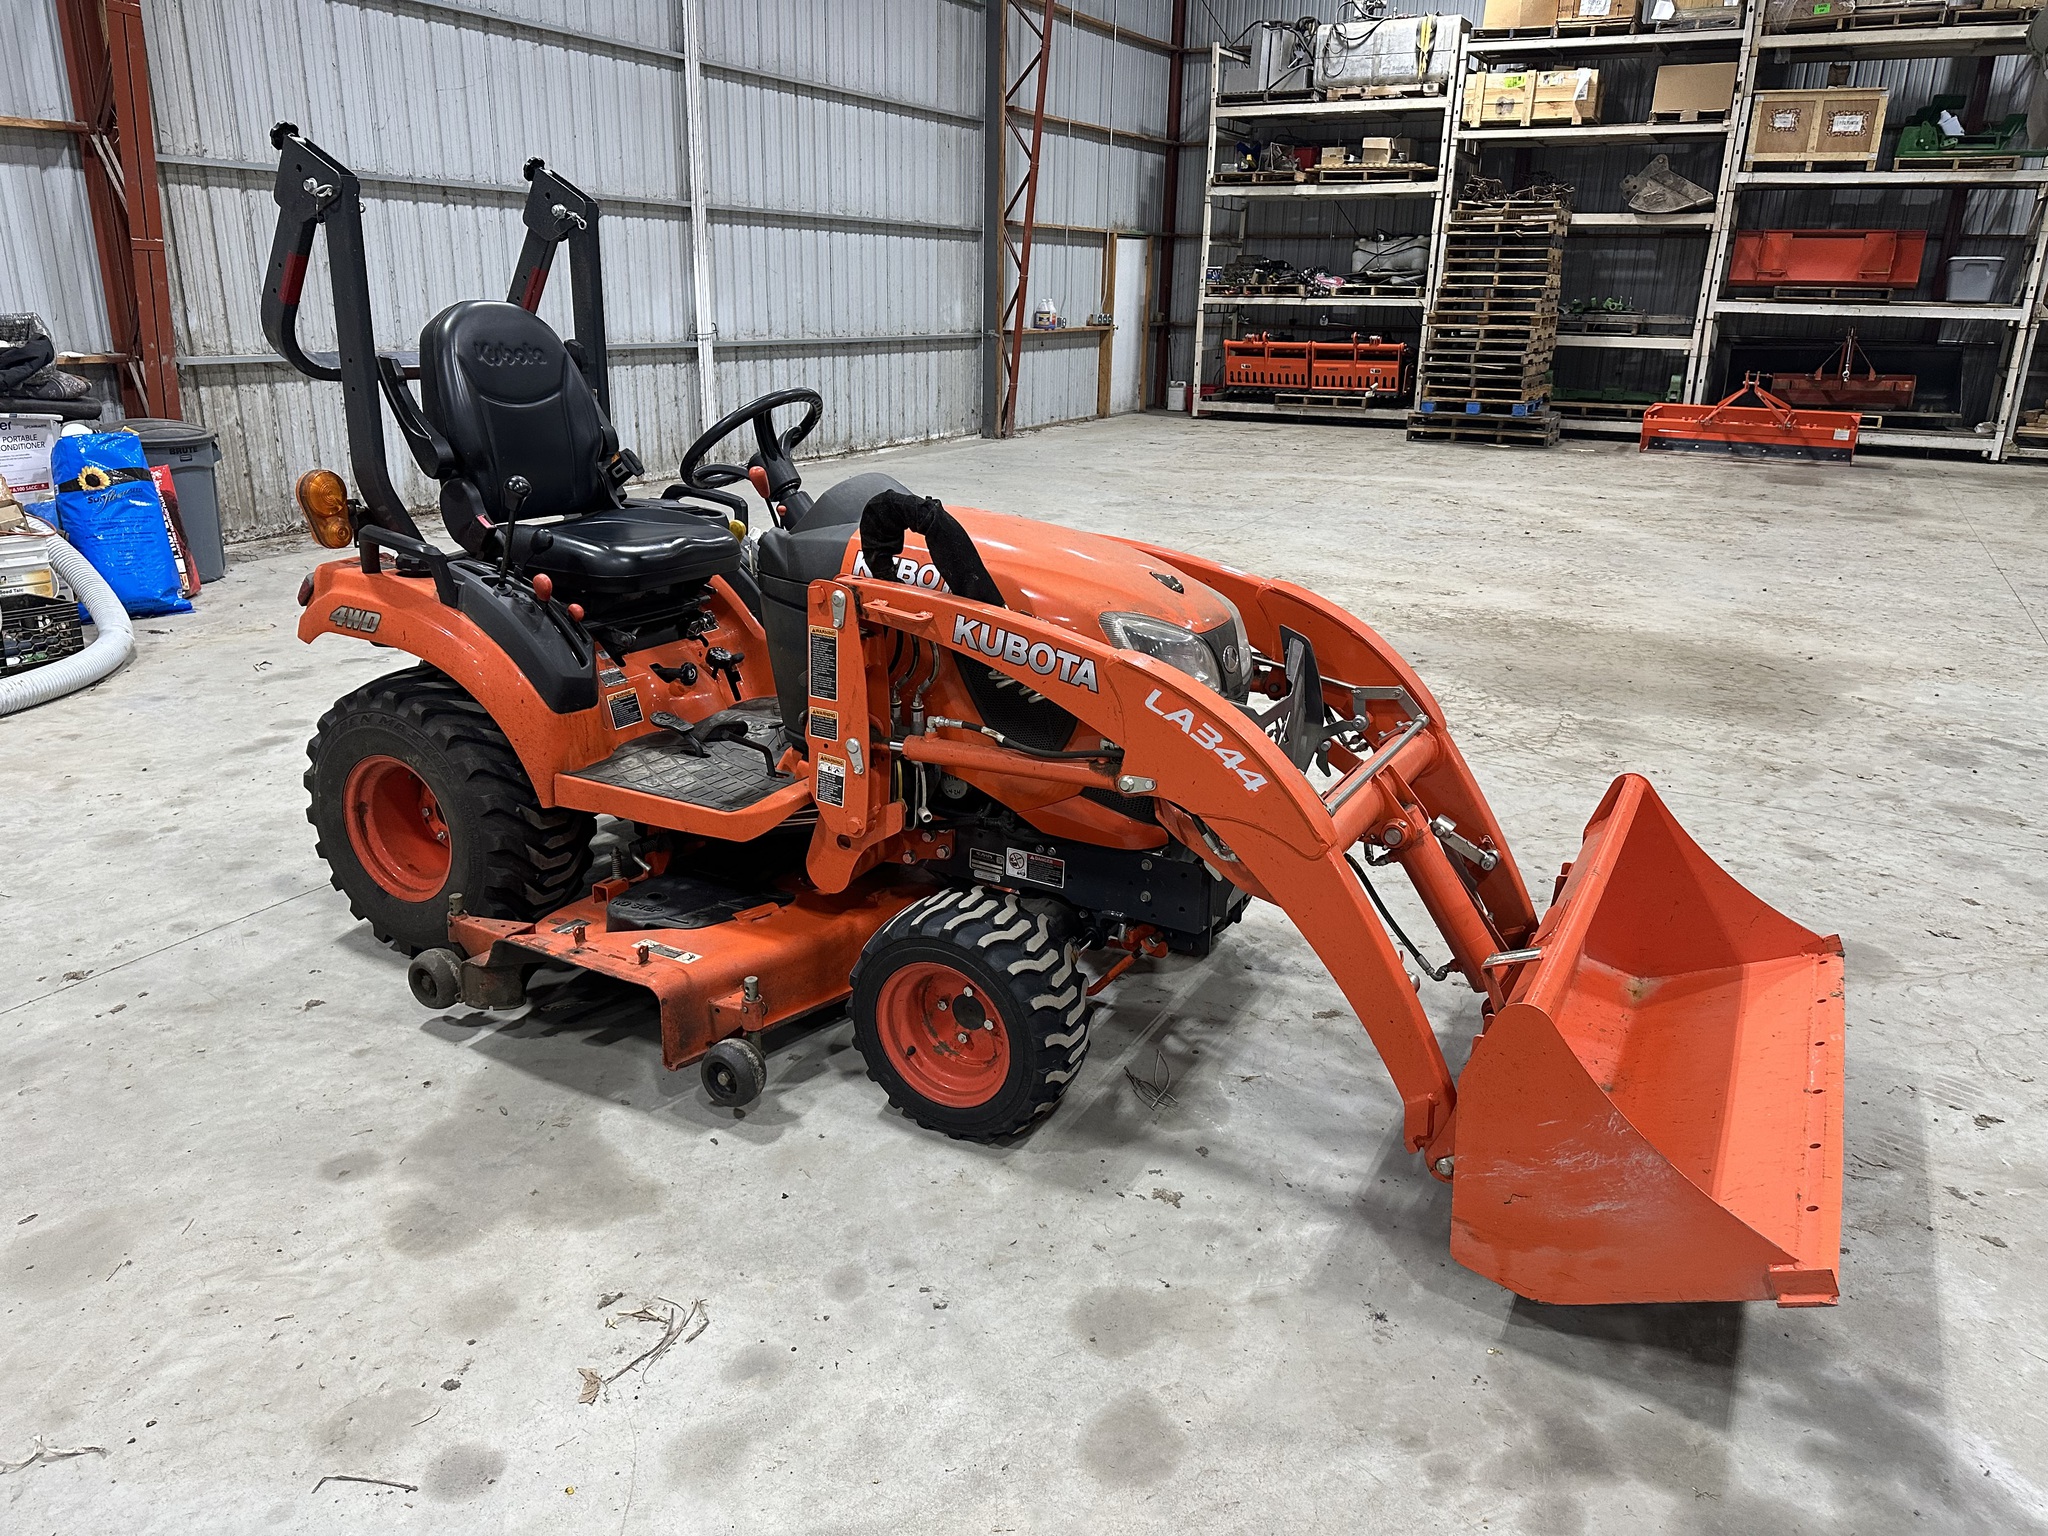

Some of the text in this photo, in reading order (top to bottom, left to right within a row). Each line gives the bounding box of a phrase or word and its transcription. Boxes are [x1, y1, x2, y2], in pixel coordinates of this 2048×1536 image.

[473, 341, 548, 367] Kubota
[0, 441, 46, 452] ONDITIONER
[2, 433, 38, 443] PORTABLE
[169, 446, 198, 455] BRUTE
[329, 605, 382, 633] 4WD
[952, 614, 1100, 694] KUBOTA
[1144, 688, 1269, 792] LA344
